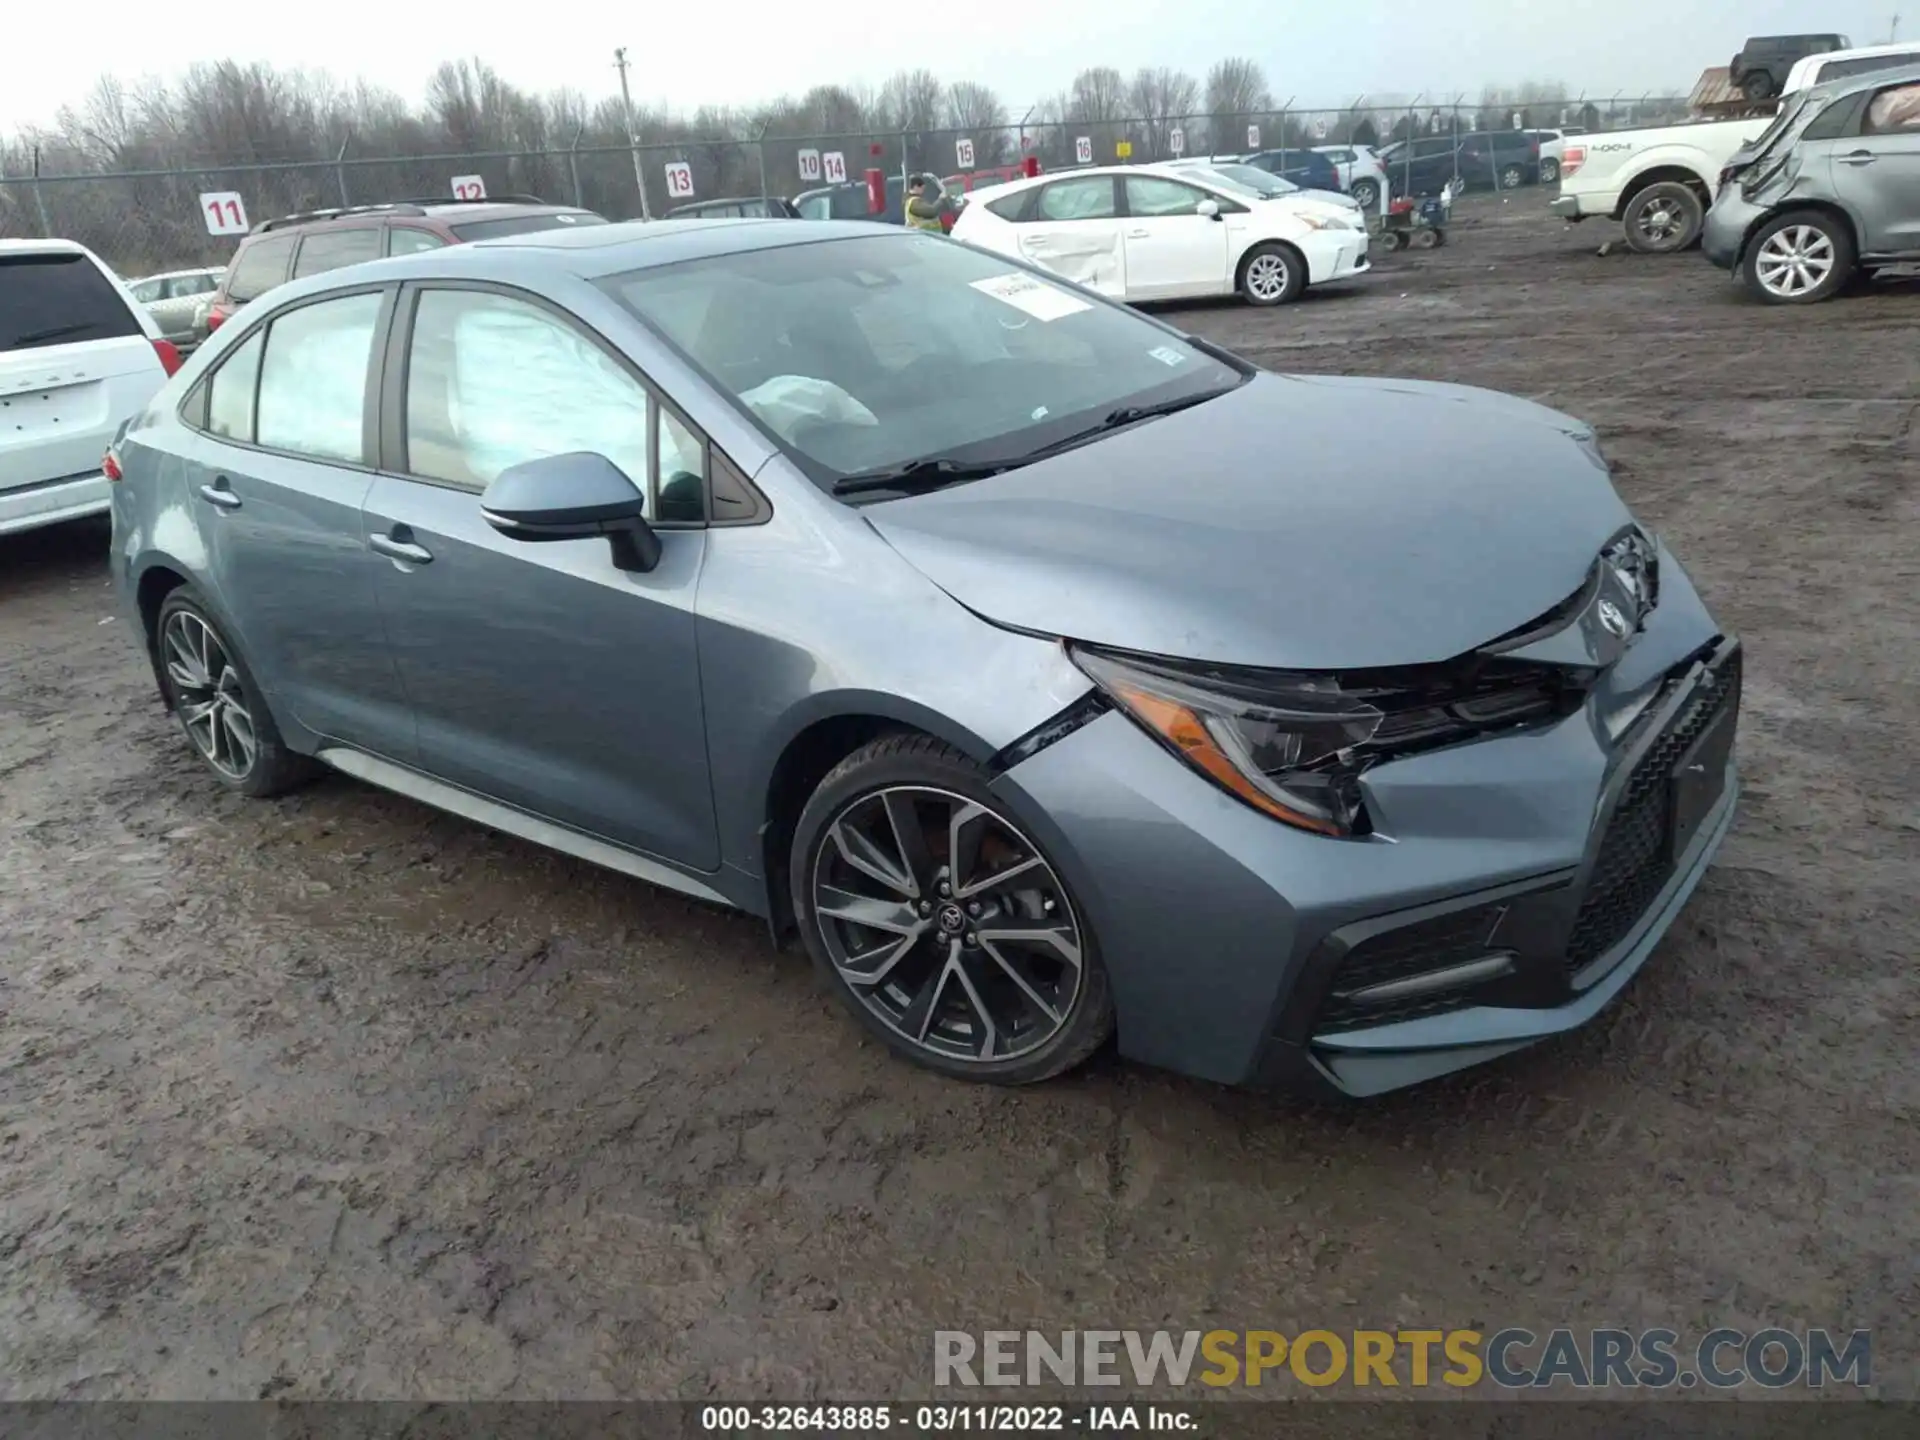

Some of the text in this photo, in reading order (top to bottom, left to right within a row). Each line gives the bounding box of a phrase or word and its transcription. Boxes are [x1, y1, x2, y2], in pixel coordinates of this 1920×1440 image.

[958, 143, 972, 162] 15
[1078, 141, 1090, 159] 16
[801, 156, 817, 174] 10
[826, 157, 843, 178] 14
[669, 169, 690, 191] 13
[456, 183, 482, 201] 12
[208, 200, 242, 227] 11
